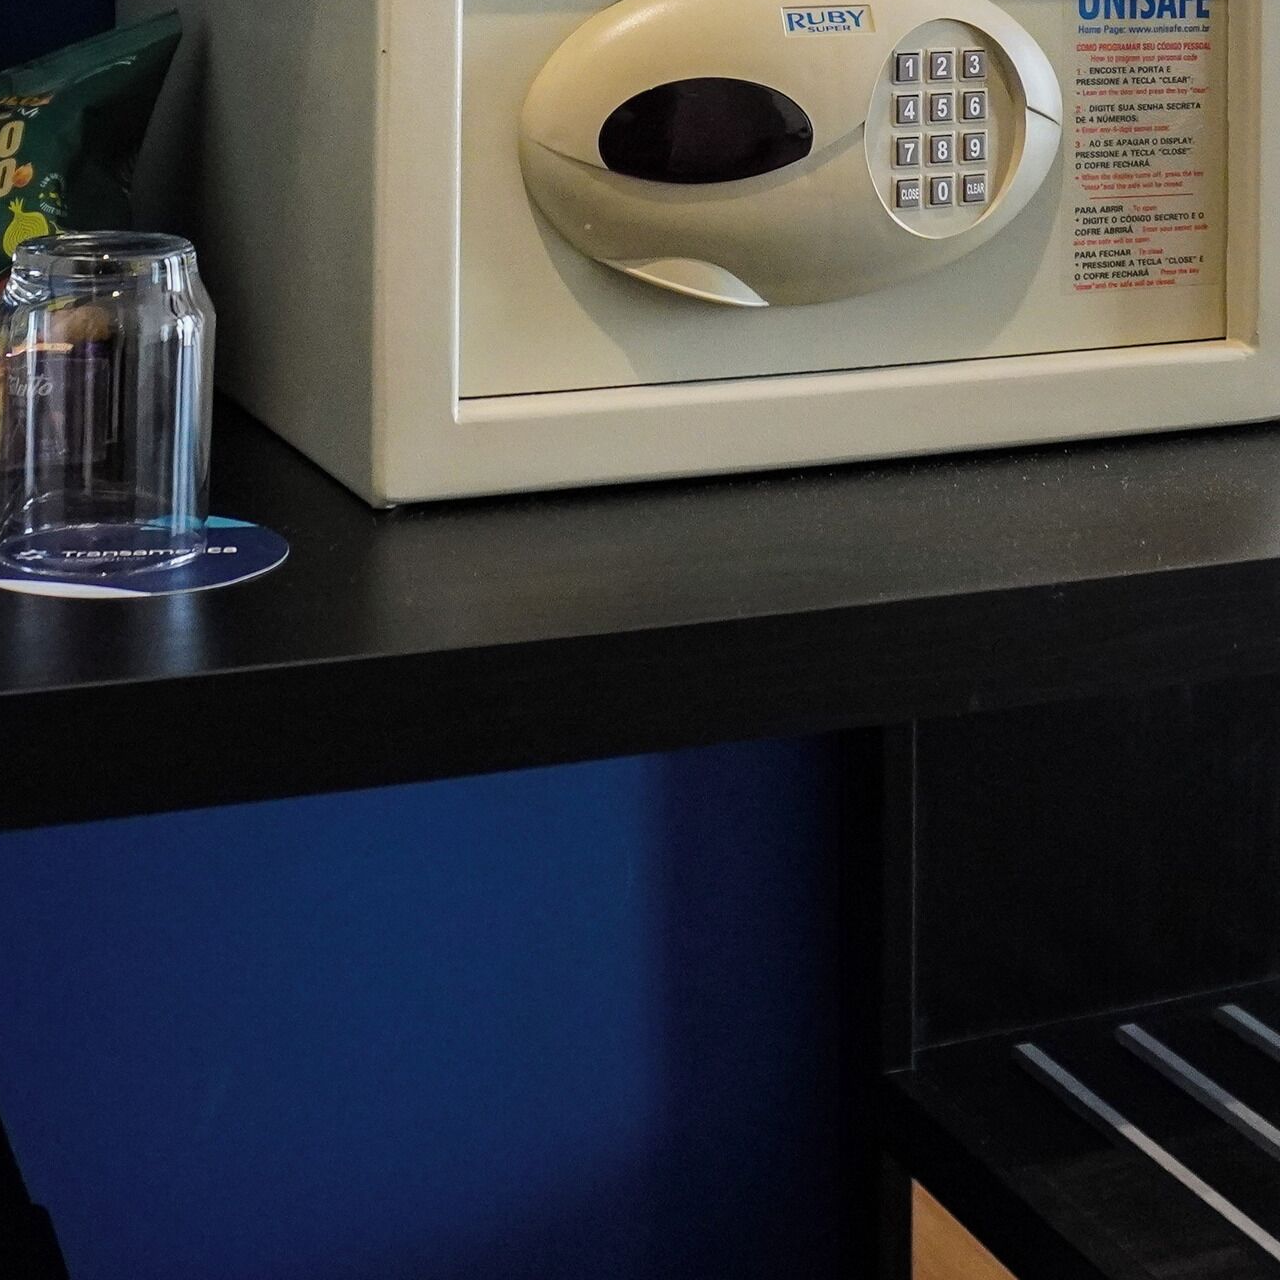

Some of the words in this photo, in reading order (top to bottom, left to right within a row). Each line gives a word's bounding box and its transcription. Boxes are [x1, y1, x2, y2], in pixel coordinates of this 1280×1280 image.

[786, 9, 864, 32] RUBY
[807, 25, 851, 33] SUPER
[1078, 25, 1101, 34] Home
[1128, 24, 1210, 34] www.unisafe.com.br
[1076, 44, 1097, 52] COMO
[1099, 43, 1141, 51] PROGRAMAR
[1142, 42, 1155, 50] SEU
[1183, 42, 1211, 50] PESSOAL
[905, 58, 913, 77] 1
[936, 57, 947, 76] 2
[969, 55, 980, 74] 3
[1076, 78, 1120, 86] PRESSIONE
[904, 100, 915, 120] 4
[937, 99, 948, 117] 5
[970, 97, 980, 116] 6
[1089, 105, 1115, 113] DIGITE
[1118, 104, 1134, 112] SUA
[1166, 102, 1201, 111] SECRETA
[1076, 116, 1086, 124] DE
[904, 143, 915, 163] 7
[937, 141, 948, 160] 8
[970, 139, 980, 157] 9
[1075, 150, 1119, 158] PRESSIONE
[1131, 149, 1155, 157] TECLA
[1075, 162, 1081, 170] O
[901, 187, 920, 200] CLOSE
[938, 182, 949, 201] 0
[967, 182, 985, 196] CLEAR
[1100, 205, 1123, 213] ABRIR
[1120, 214, 1151, 223] CÓDIGO
[1154, 212, 1189, 221] SECRETO
[1075, 229, 1101, 237] COFRE
[1099, 249, 1131, 257] FECHAR
[1082, 261, 1126, 269] PRESSIONE
[1138, 258, 1162, 266] TECLA
[1074, 273, 1081, 281] O
[1083, 272, 1109, 280] COFRE
